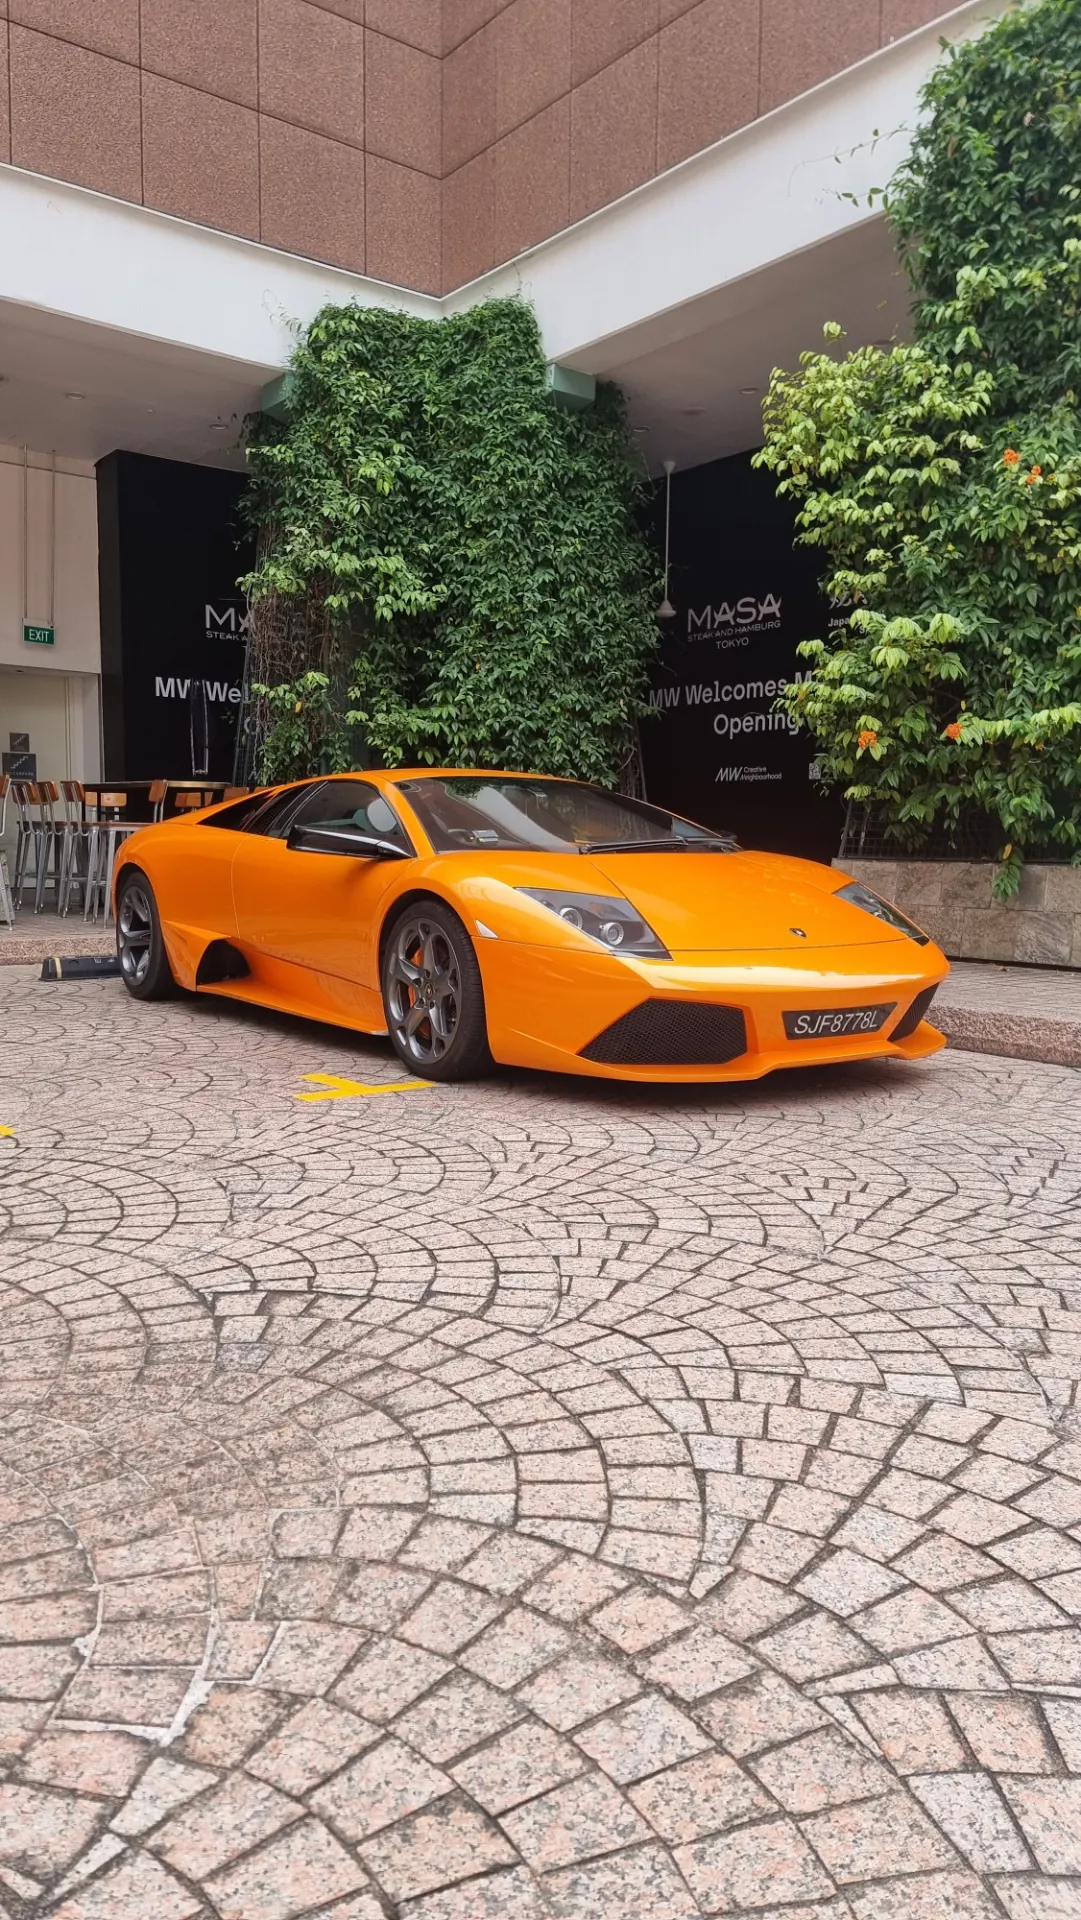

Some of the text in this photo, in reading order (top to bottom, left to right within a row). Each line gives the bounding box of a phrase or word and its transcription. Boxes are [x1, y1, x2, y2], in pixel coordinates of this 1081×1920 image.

[205, 604, 252, 633] MA
[687, 593, 782, 633] MASA
[828, 617, 851, 628] Japa
[29, 629, 50, 642] EXIT
[205, 630, 240, 641] STEAK
[687, 620, 781, 642] STEAK AND HAMBURG
[715, 636, 749, 650] TOKYO
[650, 686, 681, 708] MW
[685, 678, 788, 706] Welcomes
[713, 710, 800, 740] Opening
[715, 766, 743, 782] MW
[740, 772, 782, 783] Neighbourhood
[743, 766, 767, 774] Creative
[793, 1010, 878, 1034] SJF8778L
